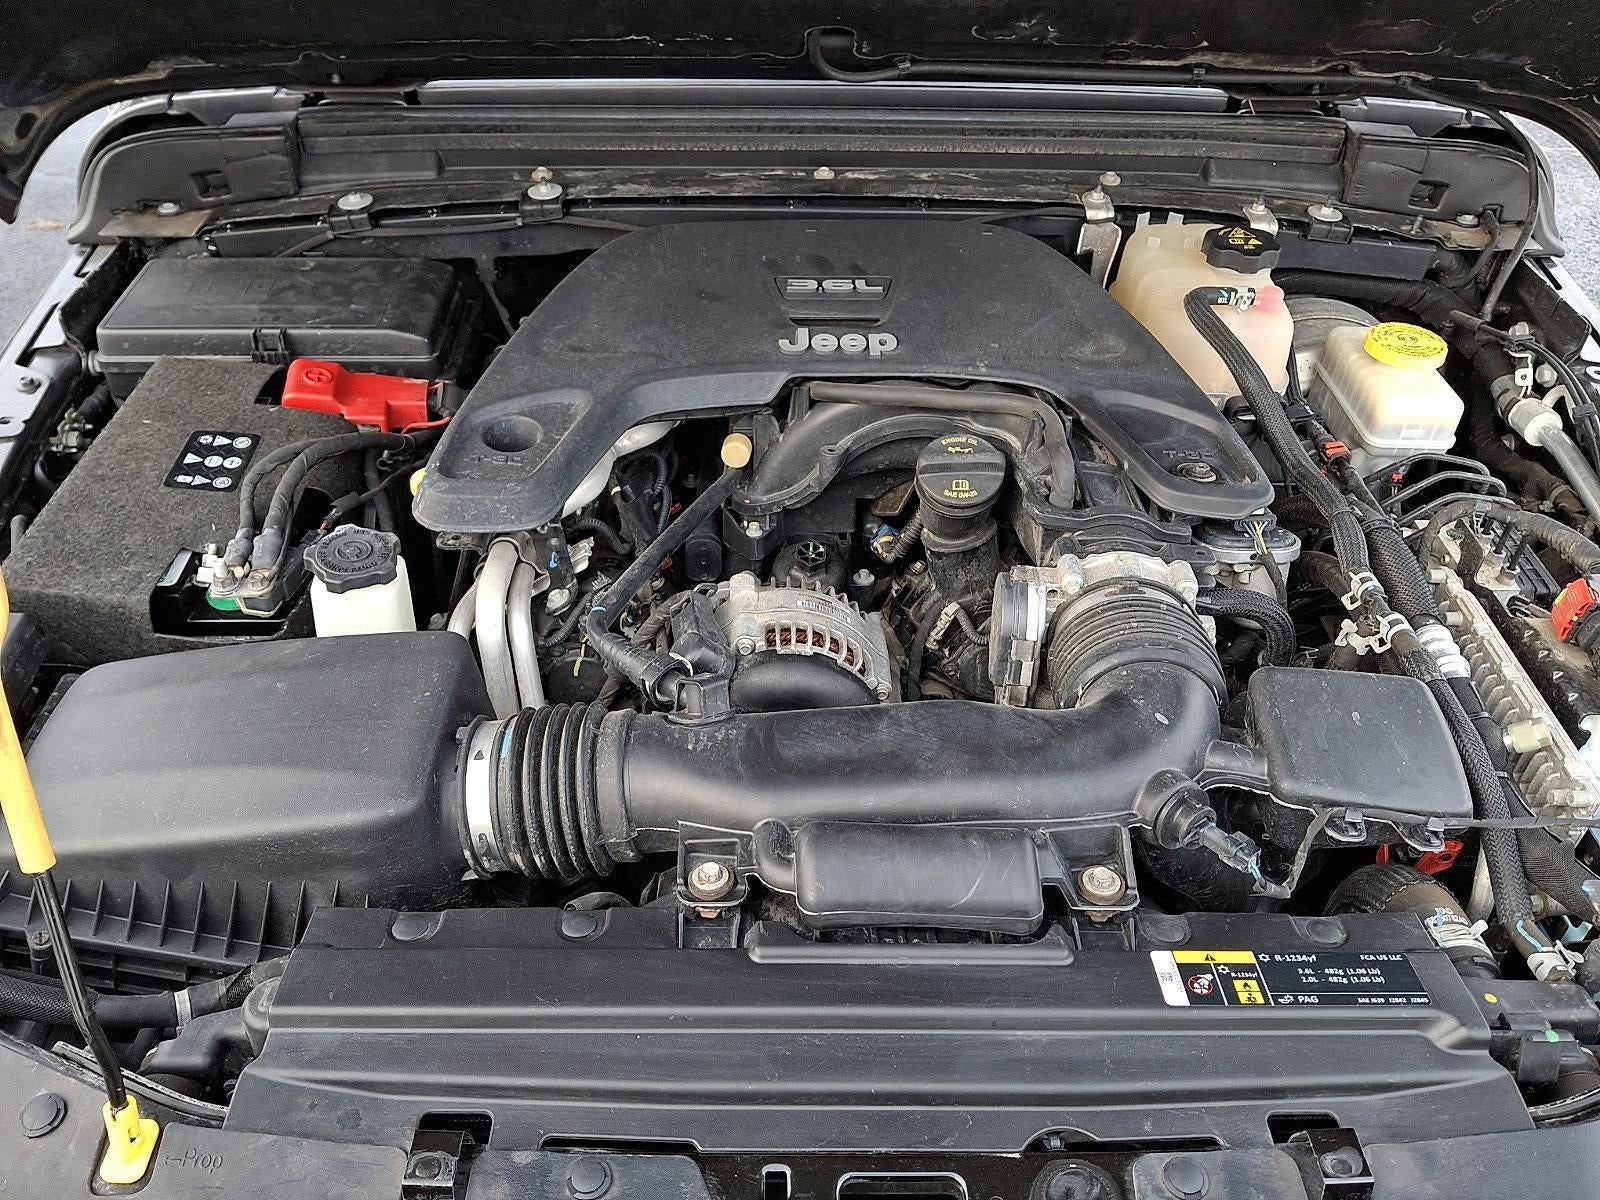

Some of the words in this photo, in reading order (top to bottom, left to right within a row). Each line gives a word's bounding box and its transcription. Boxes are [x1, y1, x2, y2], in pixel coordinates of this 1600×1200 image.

[786, 278, 884, 293] 3.6L
[778, 327, 899, 359] Jeep
[940, 436, 965, 446] ENGINE
[967, 438, 979, 446] OIL
[943, 489, 957, 498] SAE
[958, 490, 978, 499] 0W-20
[1274, 954, 1317, 963] R-1234yf
[1298, 995, 1319, 1004] PAG
[182, 1148, 223, 1174] Prop
